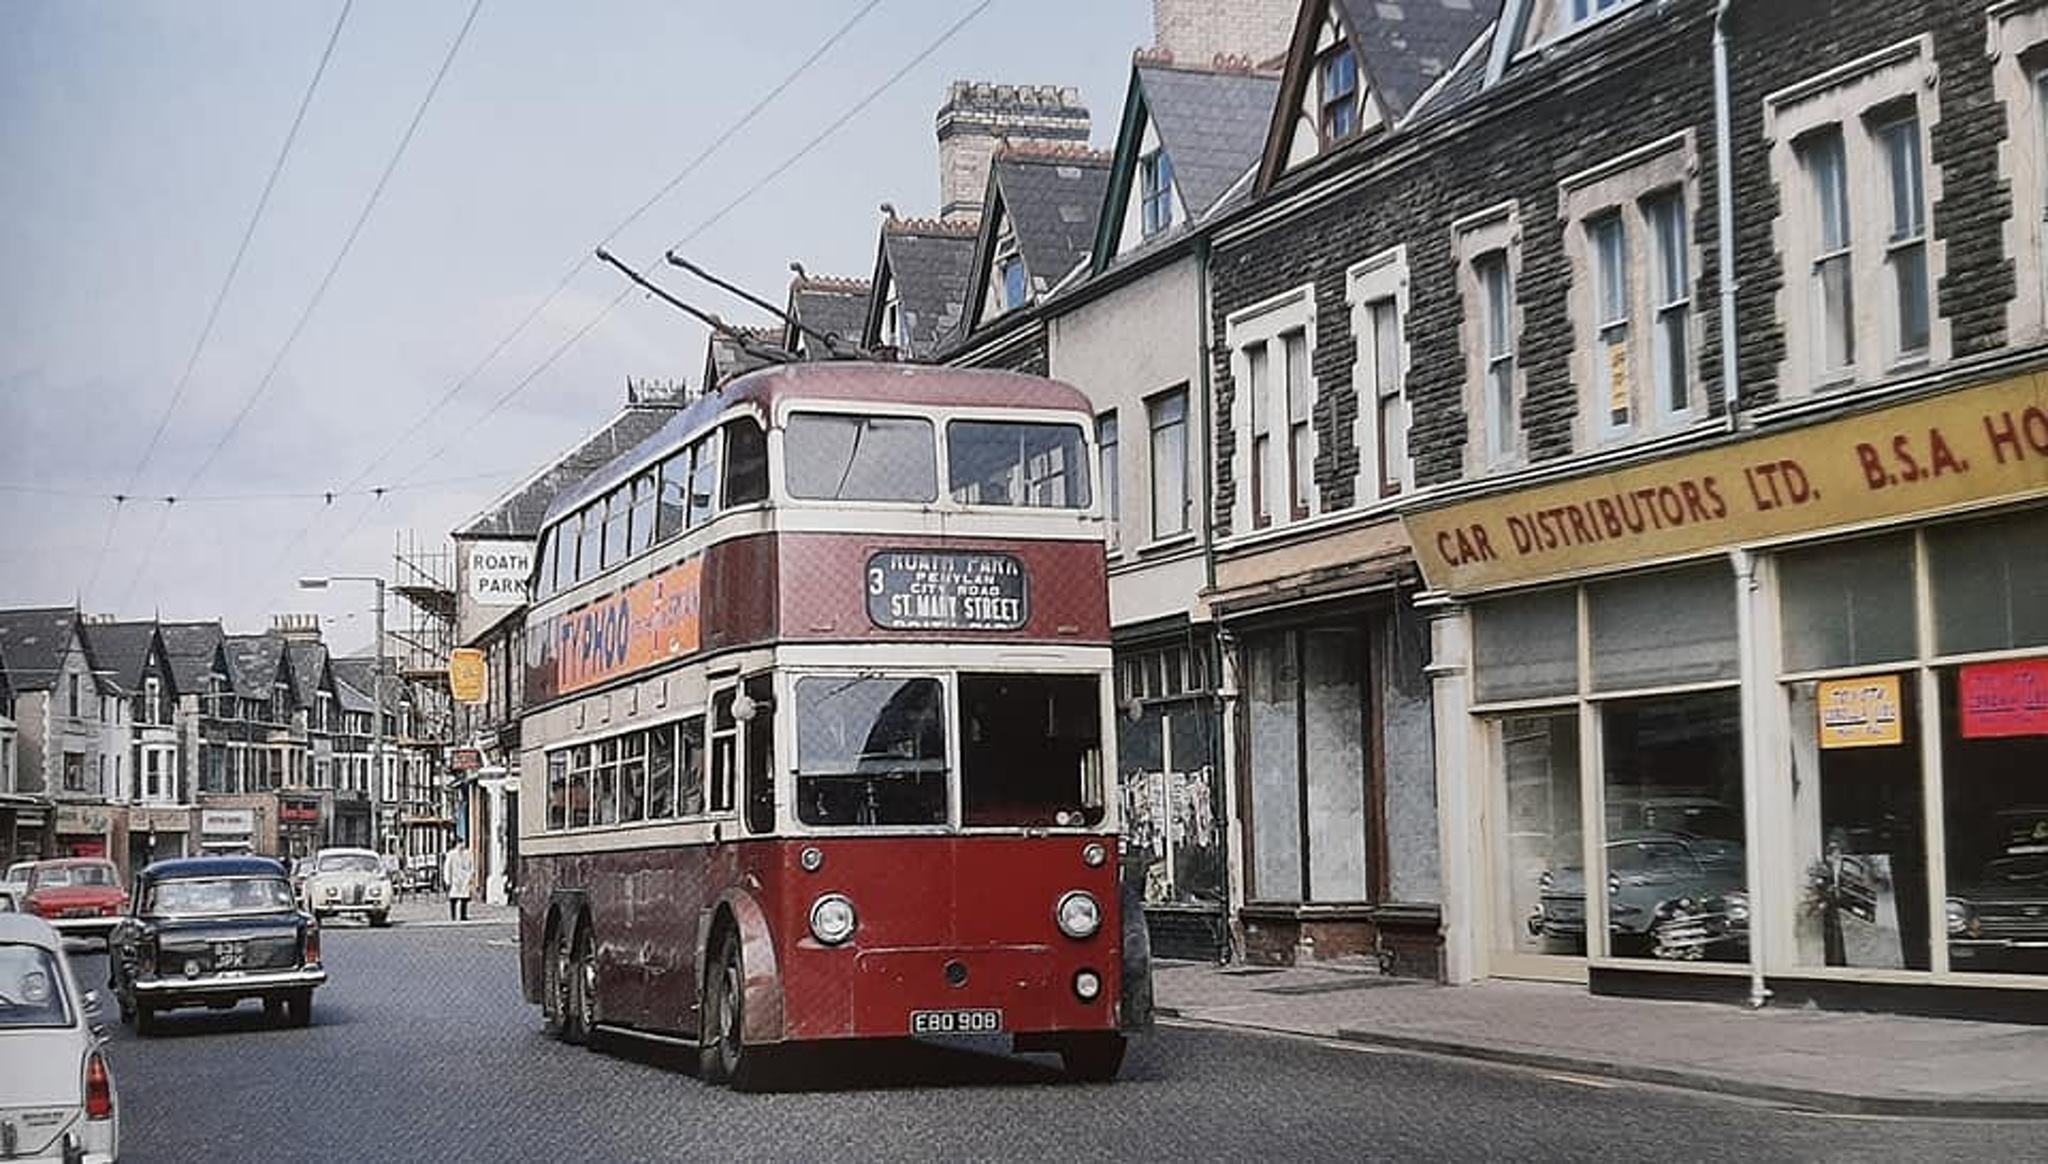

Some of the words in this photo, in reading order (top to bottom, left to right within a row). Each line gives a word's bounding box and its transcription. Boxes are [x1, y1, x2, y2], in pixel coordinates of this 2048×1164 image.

[1437, 524, 1497, 567] CAR
[1506, 476, 1727, 555] DISTRIBUTORS
[1743, 459, 1820, 511] LTD.
[1856, 427, 1969, 490] B.S.A.
[473, 555, 528, 570] ROATH
[479, 577, 527, 593] PARK
[869, 568, 884, 594] 3
[916, 572, 995, 584] PENYLAN
[910, 583, 945, 594] CITY
[957, 585, 1000, 596] ROAD
[917, 595, 957, 617] MARY
[965, 597, 1020, 621] STREET
[561, 597, 629, 685] TYPHOO
[958, 1012, 996, 1031] 908
